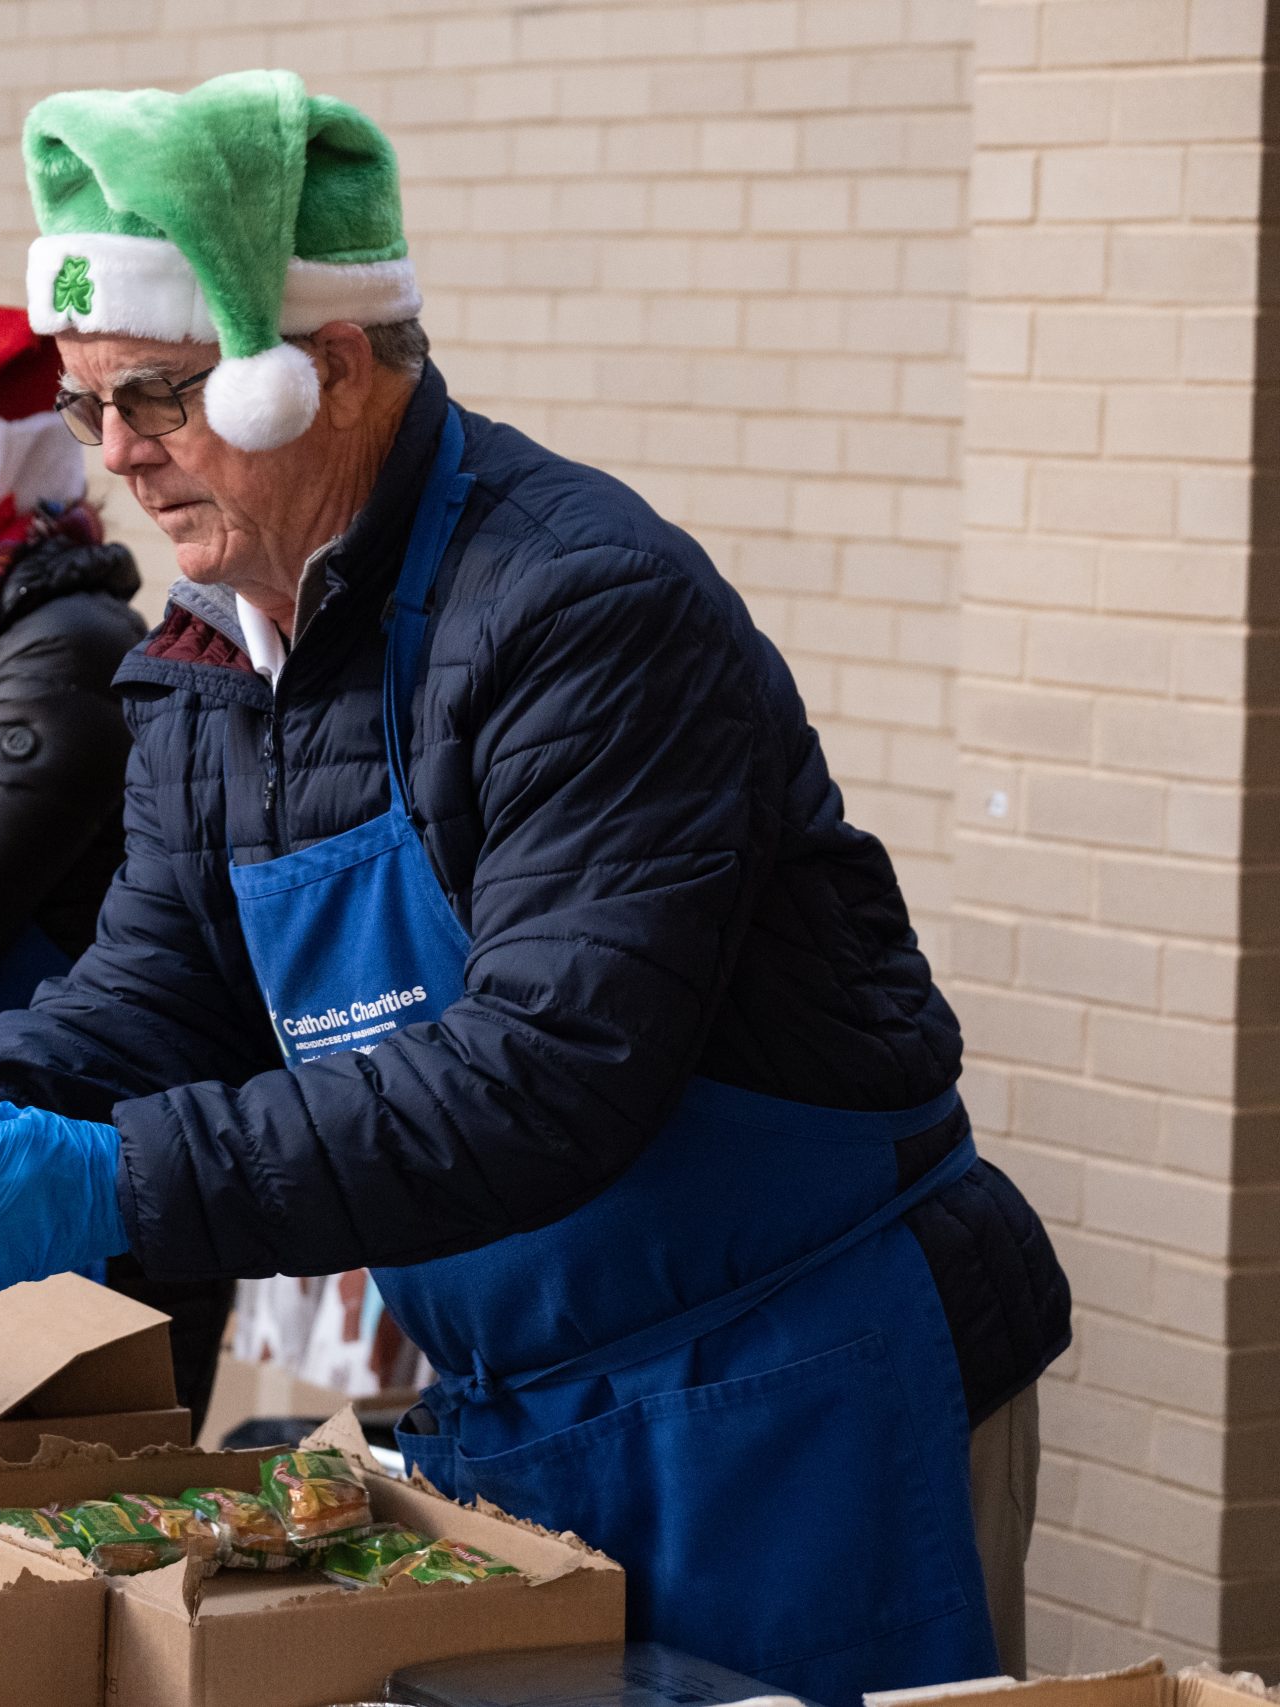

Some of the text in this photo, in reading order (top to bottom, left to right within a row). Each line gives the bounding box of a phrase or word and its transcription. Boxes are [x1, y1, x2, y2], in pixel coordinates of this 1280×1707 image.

[283, 985, 427, 1037] Catholic Charities
[342, 1032, 352, 1042] OF
[351, 1021, 397, 1040] WASHINGTON
